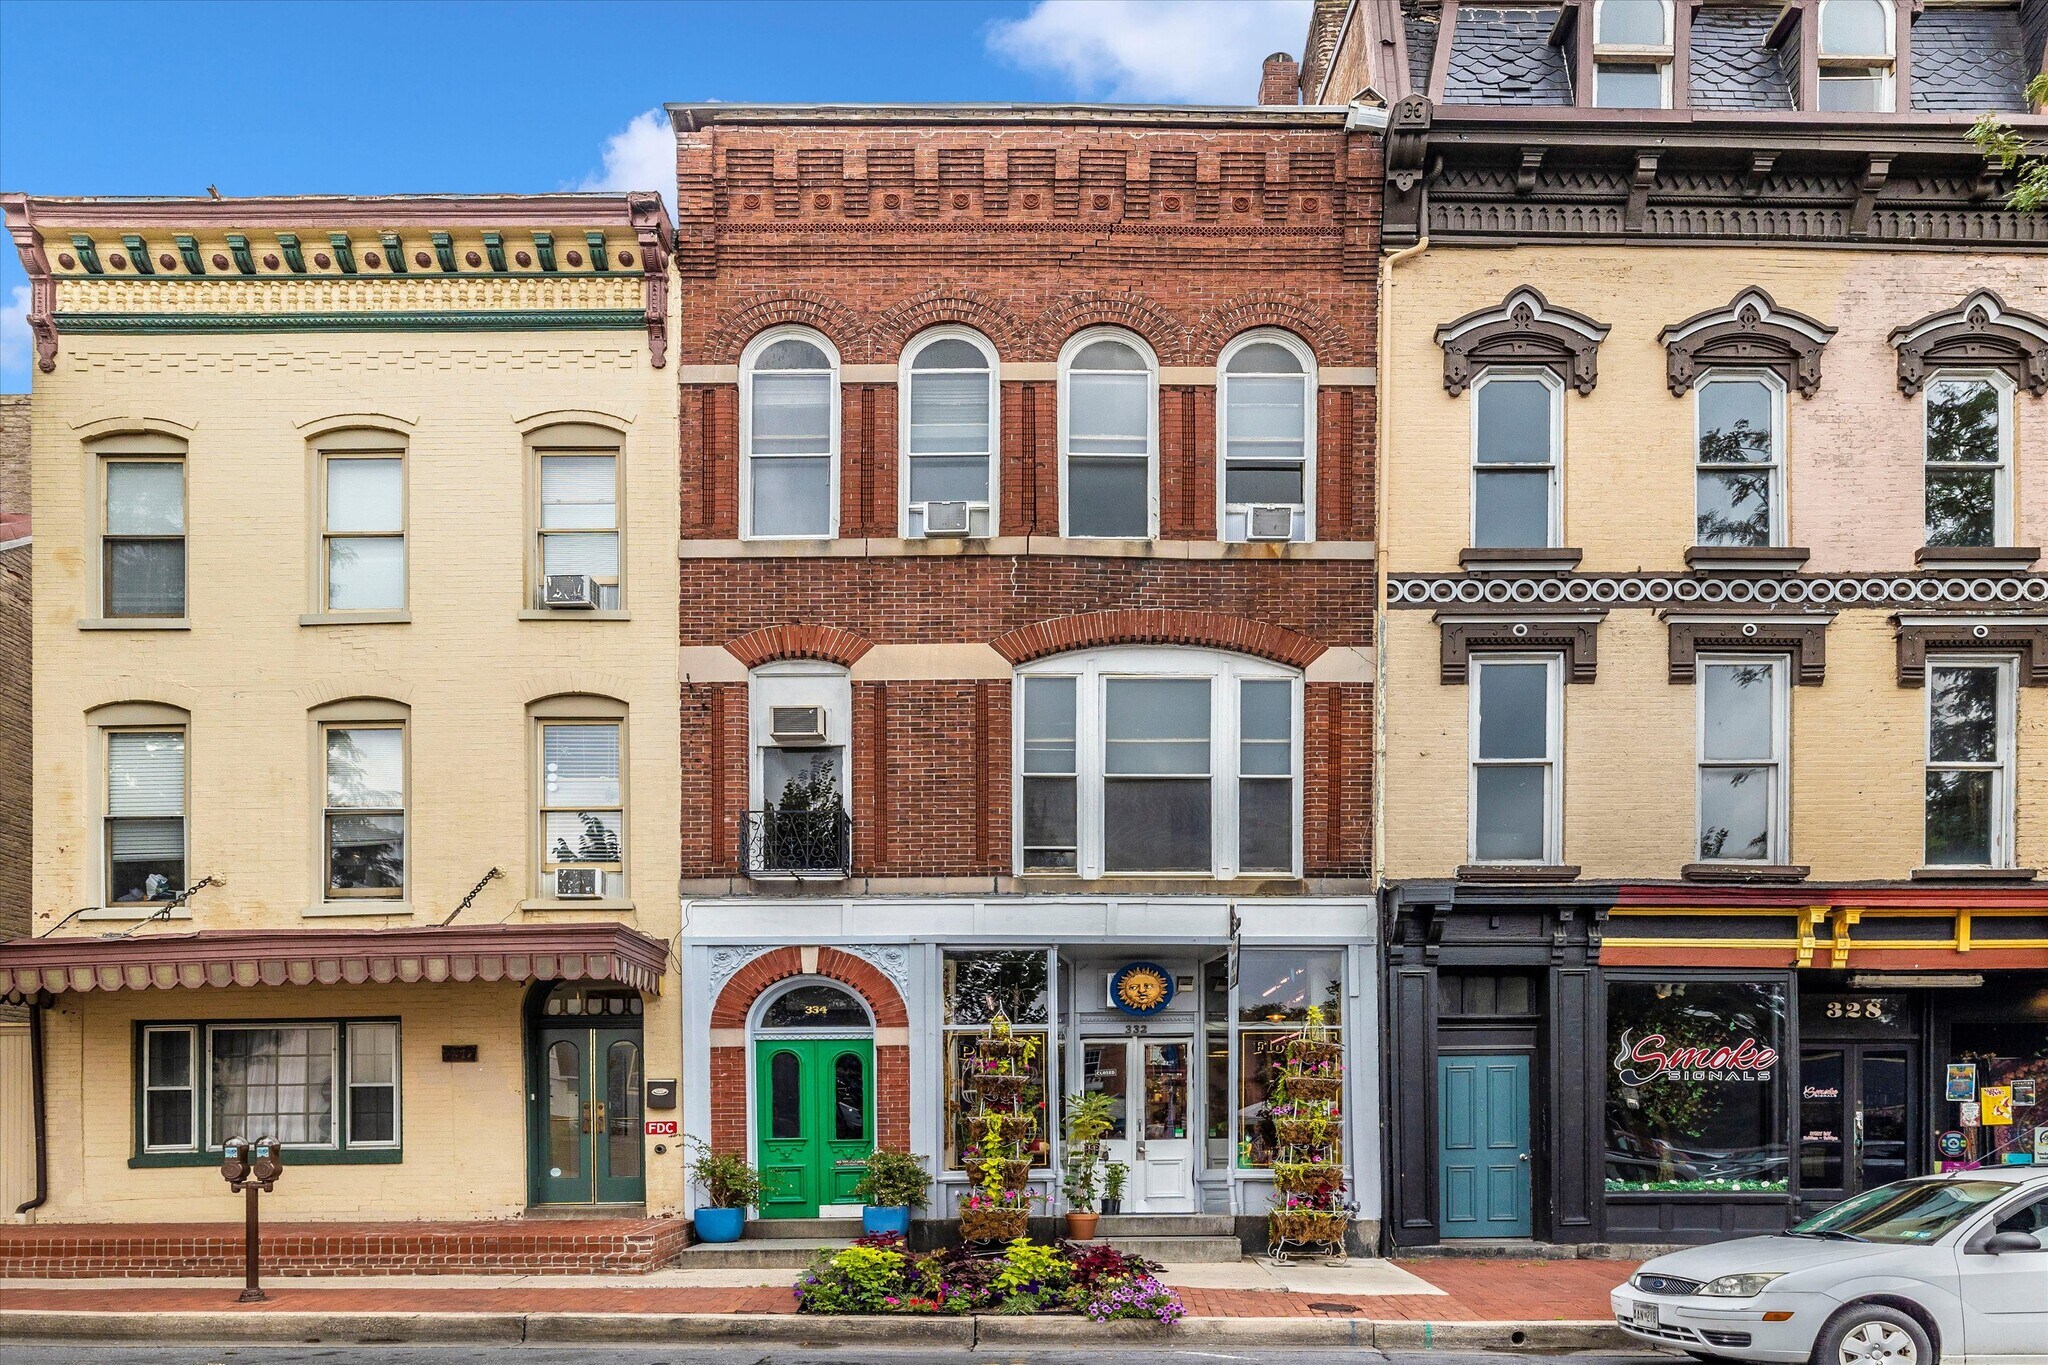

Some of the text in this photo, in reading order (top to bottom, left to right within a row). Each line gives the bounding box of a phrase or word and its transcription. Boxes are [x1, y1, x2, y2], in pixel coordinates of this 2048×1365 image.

[805, 1006, 828, 1014] 334
[1826, 1002, 1882, 1018] 328
[1125, 1025, 1148, 1034] 332
[1632, 1034, 1779, 1071] Smoke
[1668, 1071, 1771, 1081] SIGNALS
[648, 1122, 674, 1134] FDC
